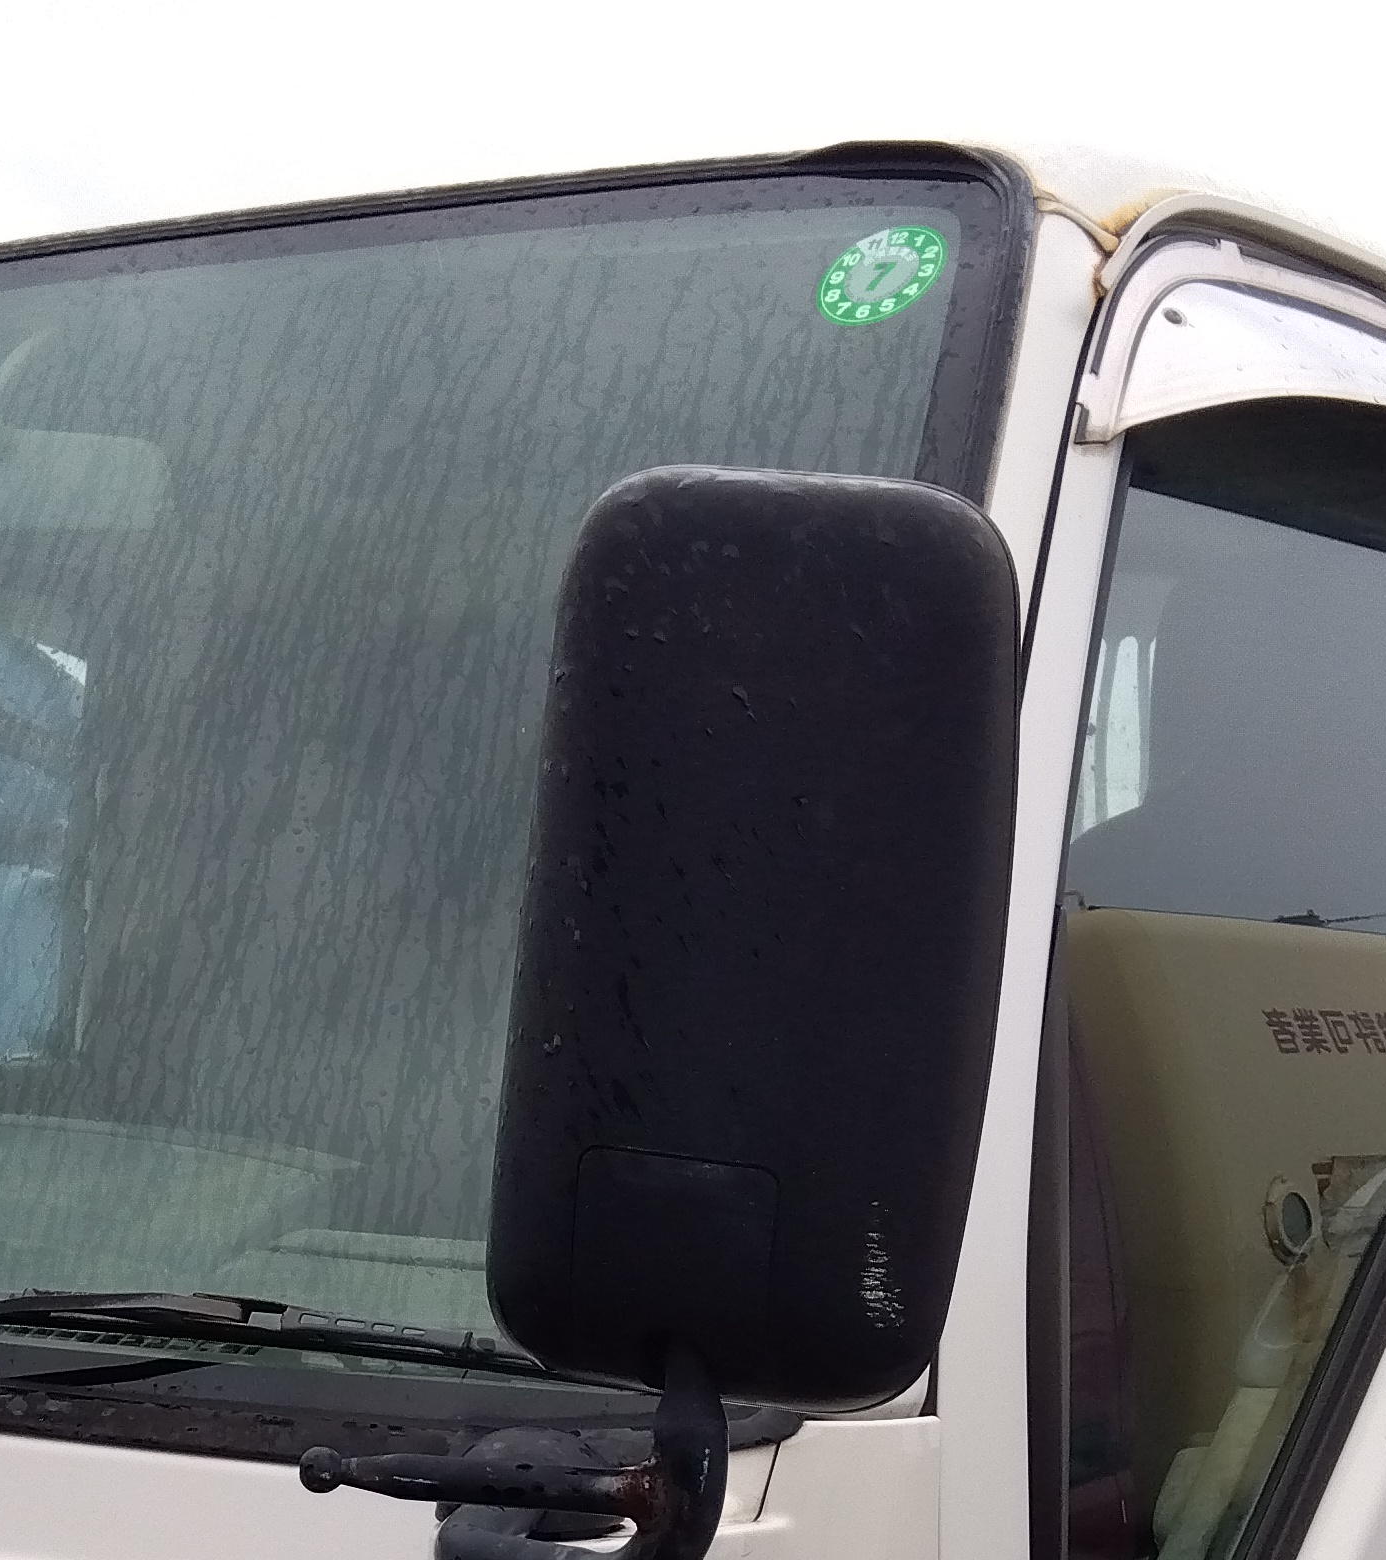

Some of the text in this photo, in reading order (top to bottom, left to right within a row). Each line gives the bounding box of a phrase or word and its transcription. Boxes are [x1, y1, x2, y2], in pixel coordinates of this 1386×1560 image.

[891, 232, 909, 244] 12
[914, 234, 926, 247] 1
[921, 246, 939, 259] 2
[843, 253, 861, 266] 10
[865, 262, 896, 292] 7
[918, 264, 934, 277] 3
[829, 271, 845, 284] 9
[825, 289, 841, 302] 8
[903, 283, 919, 296] 4
[836, 302, 852, 315] 7
[879, 298, 896, 312] 5
[855, 305, 871, 319] 6
